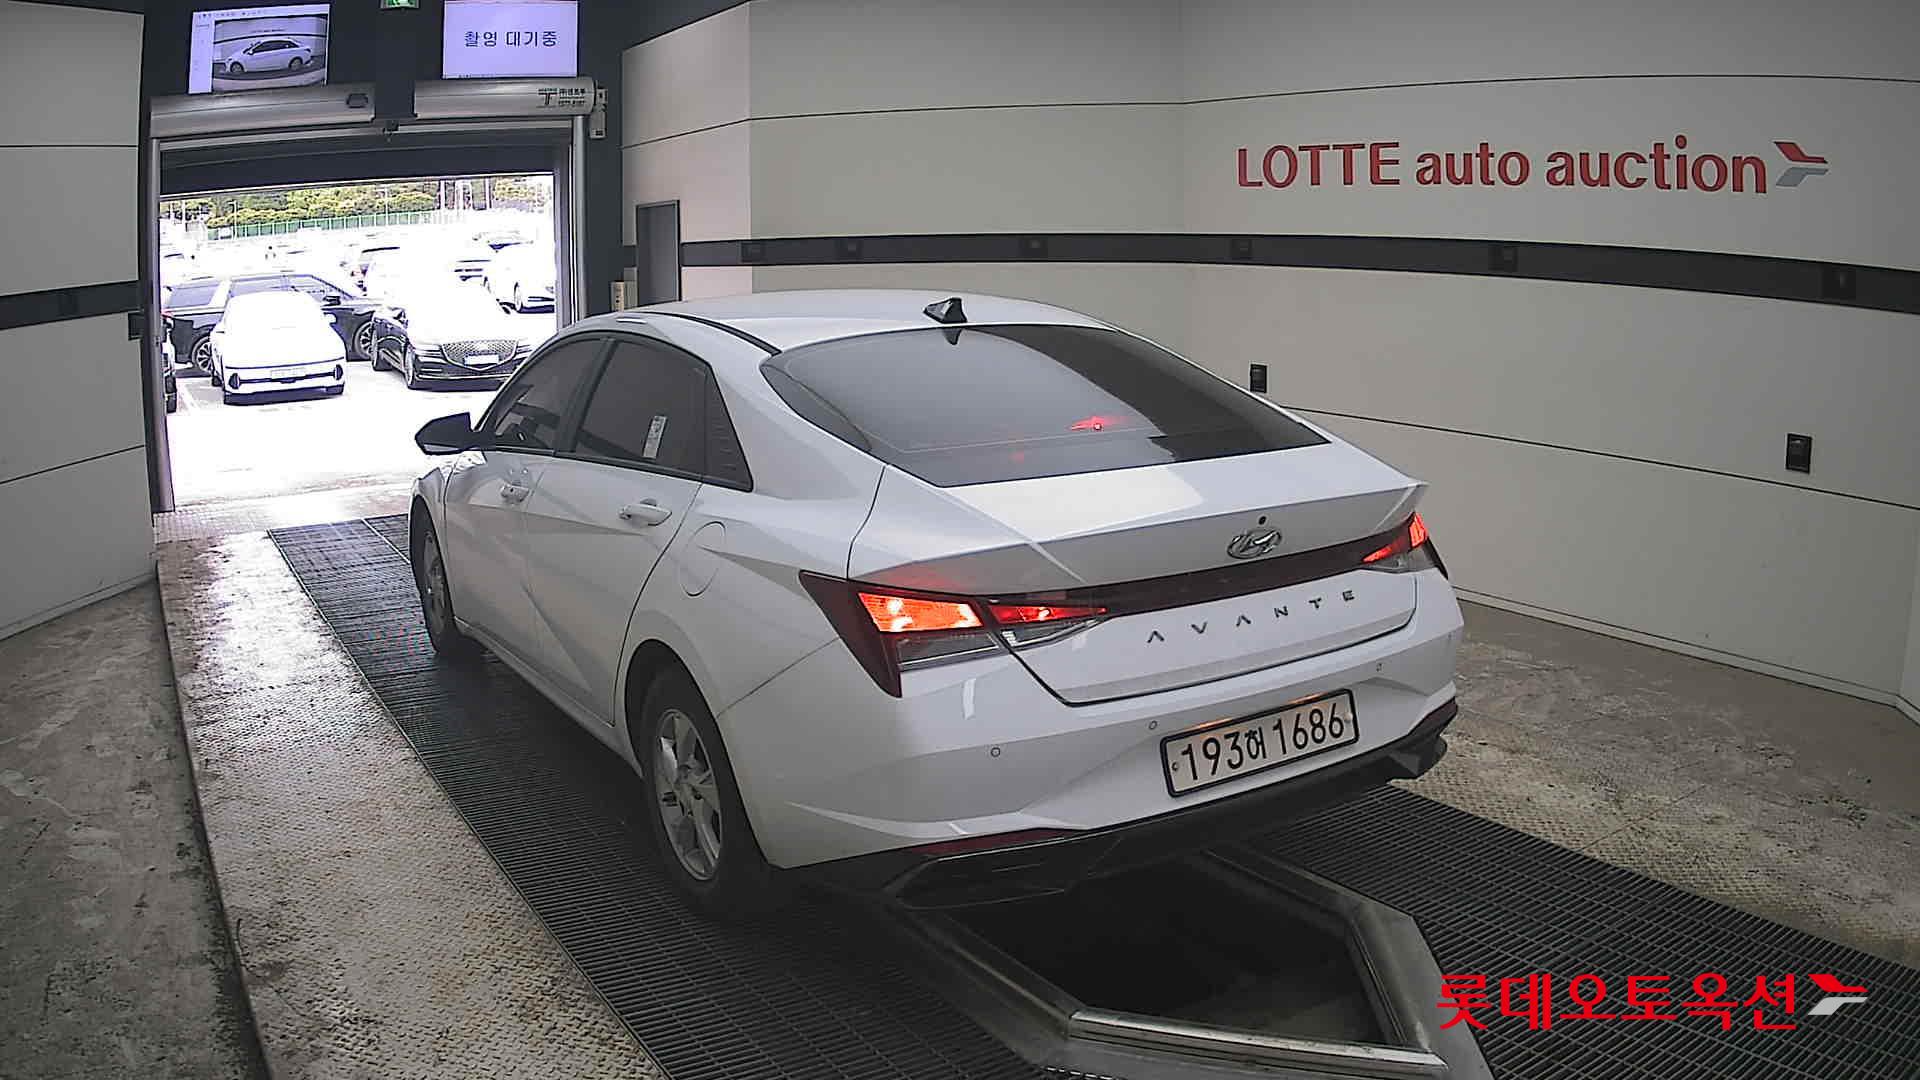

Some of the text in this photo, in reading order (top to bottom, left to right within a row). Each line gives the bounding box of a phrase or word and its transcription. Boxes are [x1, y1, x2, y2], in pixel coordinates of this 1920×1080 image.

[464, 31, 558, 47] 촬영 대기중
[1237, 134, 1768, 194] LOTTE auto auction
[1146, 590, 1355, 644] AVANTE
